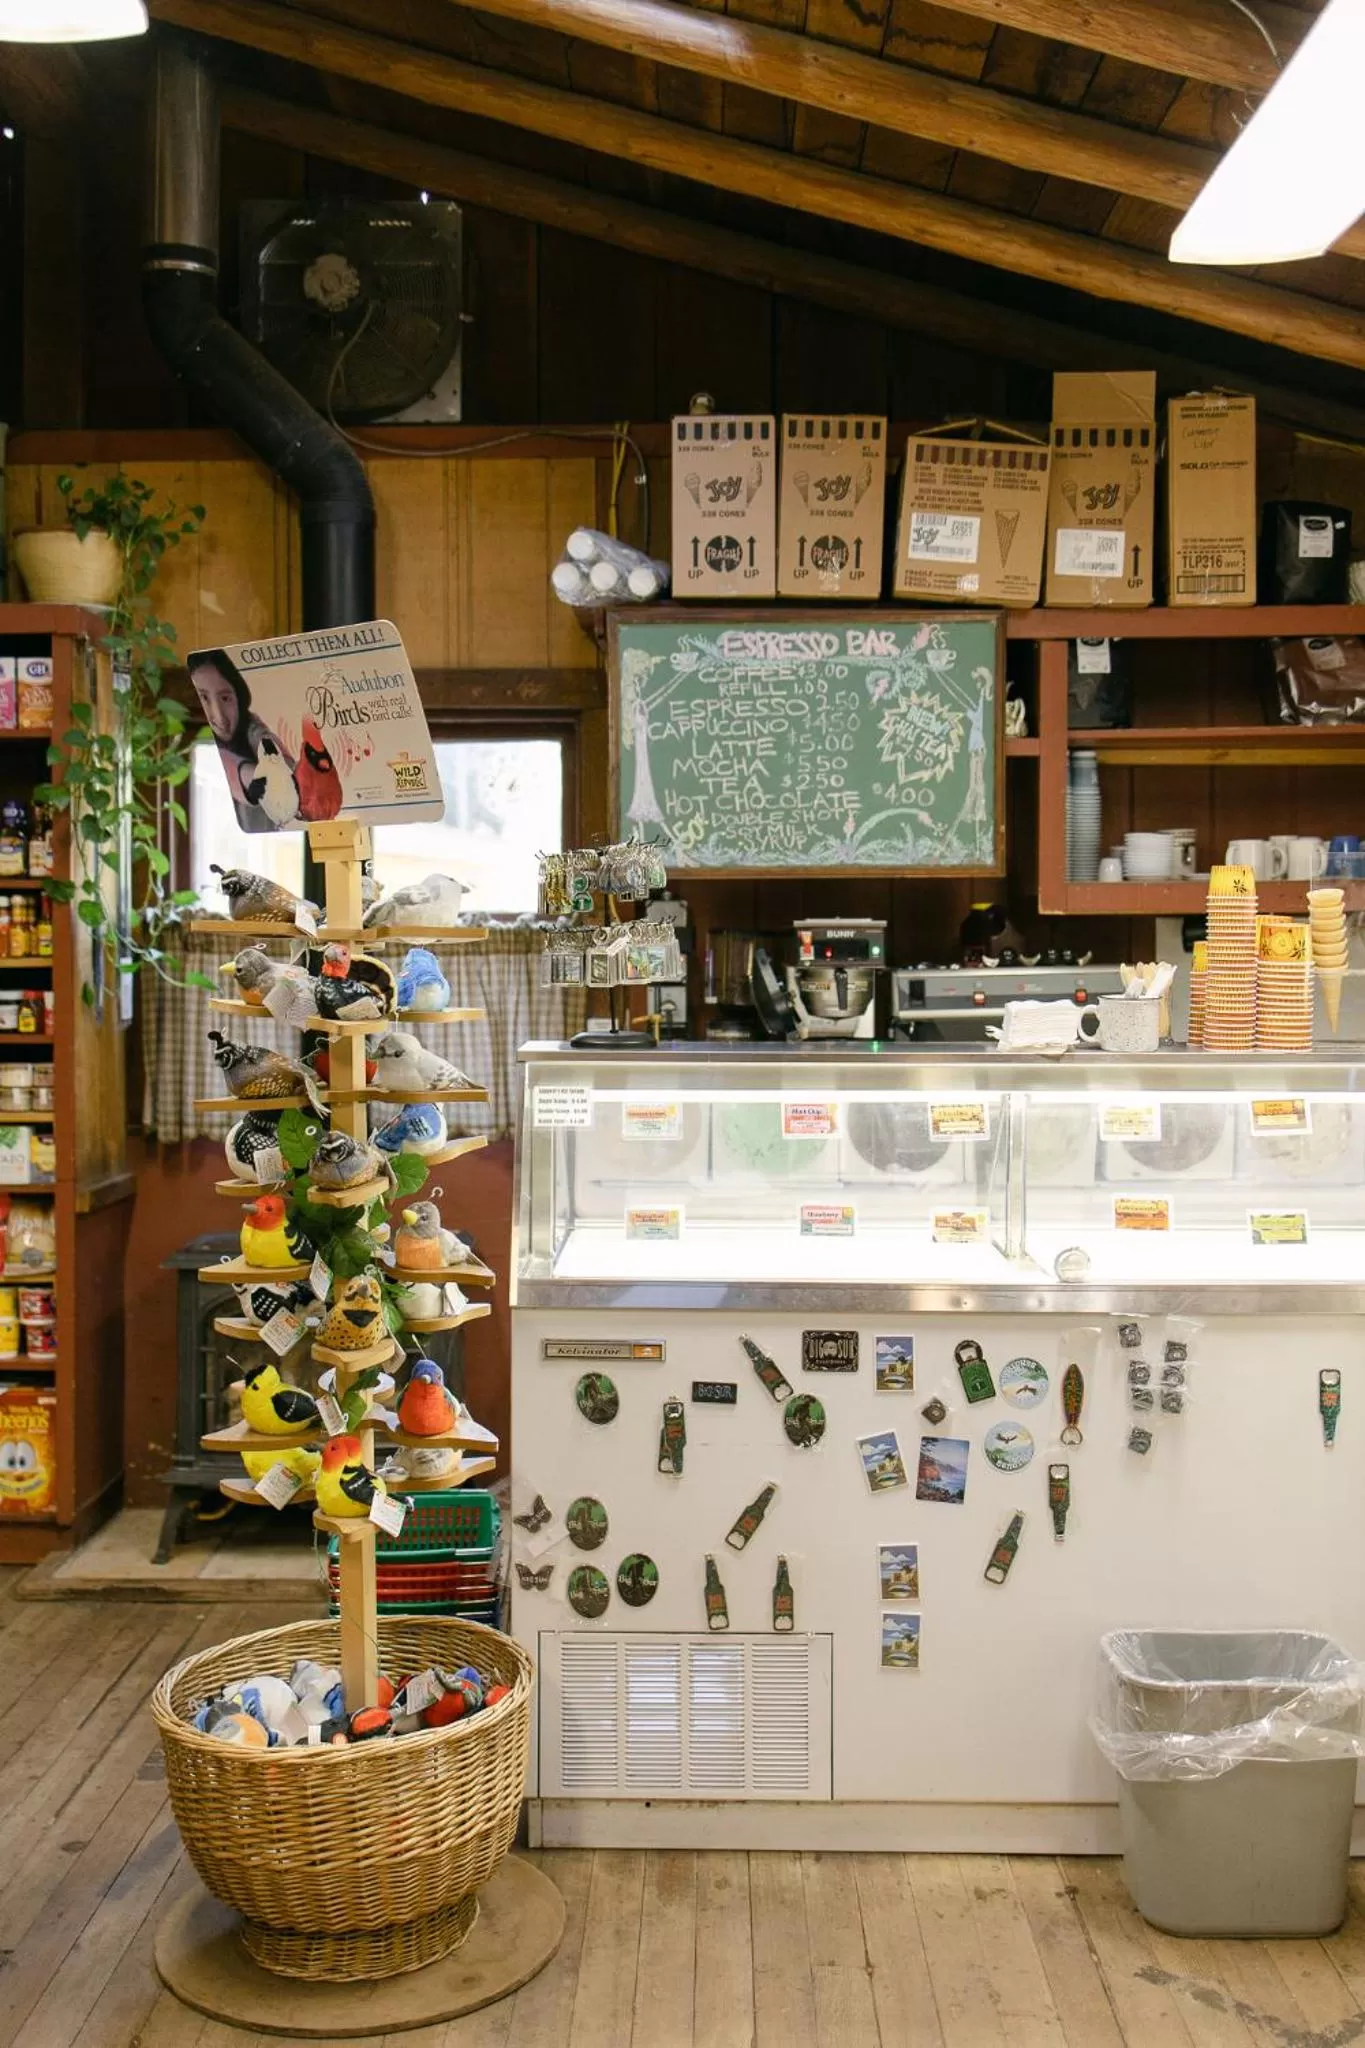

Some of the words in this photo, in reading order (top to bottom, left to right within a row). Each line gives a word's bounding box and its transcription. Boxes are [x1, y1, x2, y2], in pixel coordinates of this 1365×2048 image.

[688, 570, 704, 579] UP
[744, 569, 760, 579] UP
[793, 569, 809, 579] UP
[849, 571, 865, 581] UP
[1127, 578, 1143, 589] UP
[240, 643, 303, 665] COLLECT
[305, 633, 350, 655] THEM
[353, 627, 386, 648] ALL!
[721, 629, 840, 661] ESPRESSO
[845, 628, 901, 657] BAR
[340, 669, 406, 696] Audubon
[698, 666, 797, 684] COFFEE
[718, 681, 788, 697] REFILL
[306, 685, 372, 730] Birds
[368, 696, 388, 709] with
[388, 692, 407, 706] real
[371, 710, 390, 723] bird
[669, 698, 810, 721] ESPRESSO
[648, 718, 789, 742] CAPPUCCINO
[692, 736, 778, 760] LATTE
[393, 765, 422, 779] WILD
[672, 755, 771, 779] MOCHA
[699, 774, 764, 795] TEA
[664, 788, 709, 821] HOT
[715, 790, 863, 814] CHOCOLATE
[711, 811, 784, 828] DOUBLE
[767, 822, 823, 838] MILK
[743, 834, 808, 851] SYRUP
[826, 930, 855, 938] BUNN
[557, 1346, 622, 1356] Kelvinator
